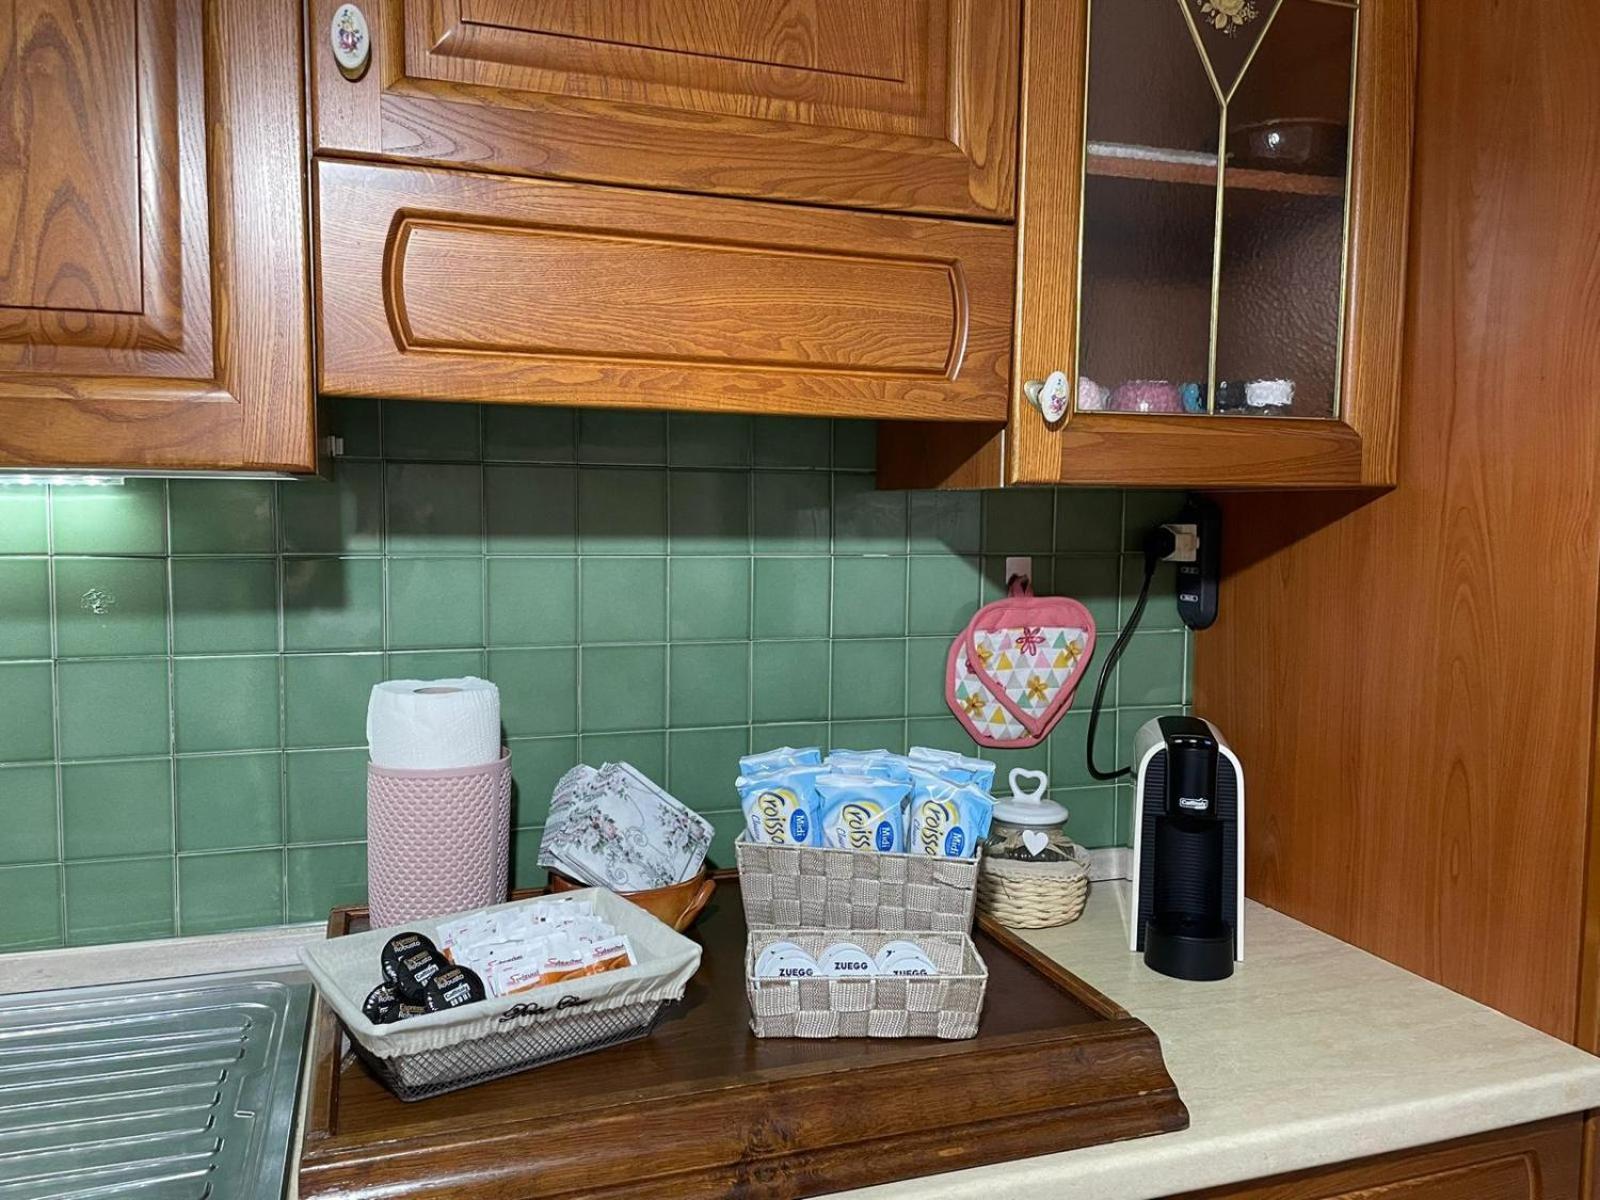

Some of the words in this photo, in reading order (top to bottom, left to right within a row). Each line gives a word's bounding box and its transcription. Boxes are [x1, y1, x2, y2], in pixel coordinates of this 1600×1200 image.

[796, 815, 806, 836] Midi
[842, 803, 872, 849] Croiss
[779, 968, 814, 977] ZUEGG
[834, 962, 868, 970] ZUEGG
